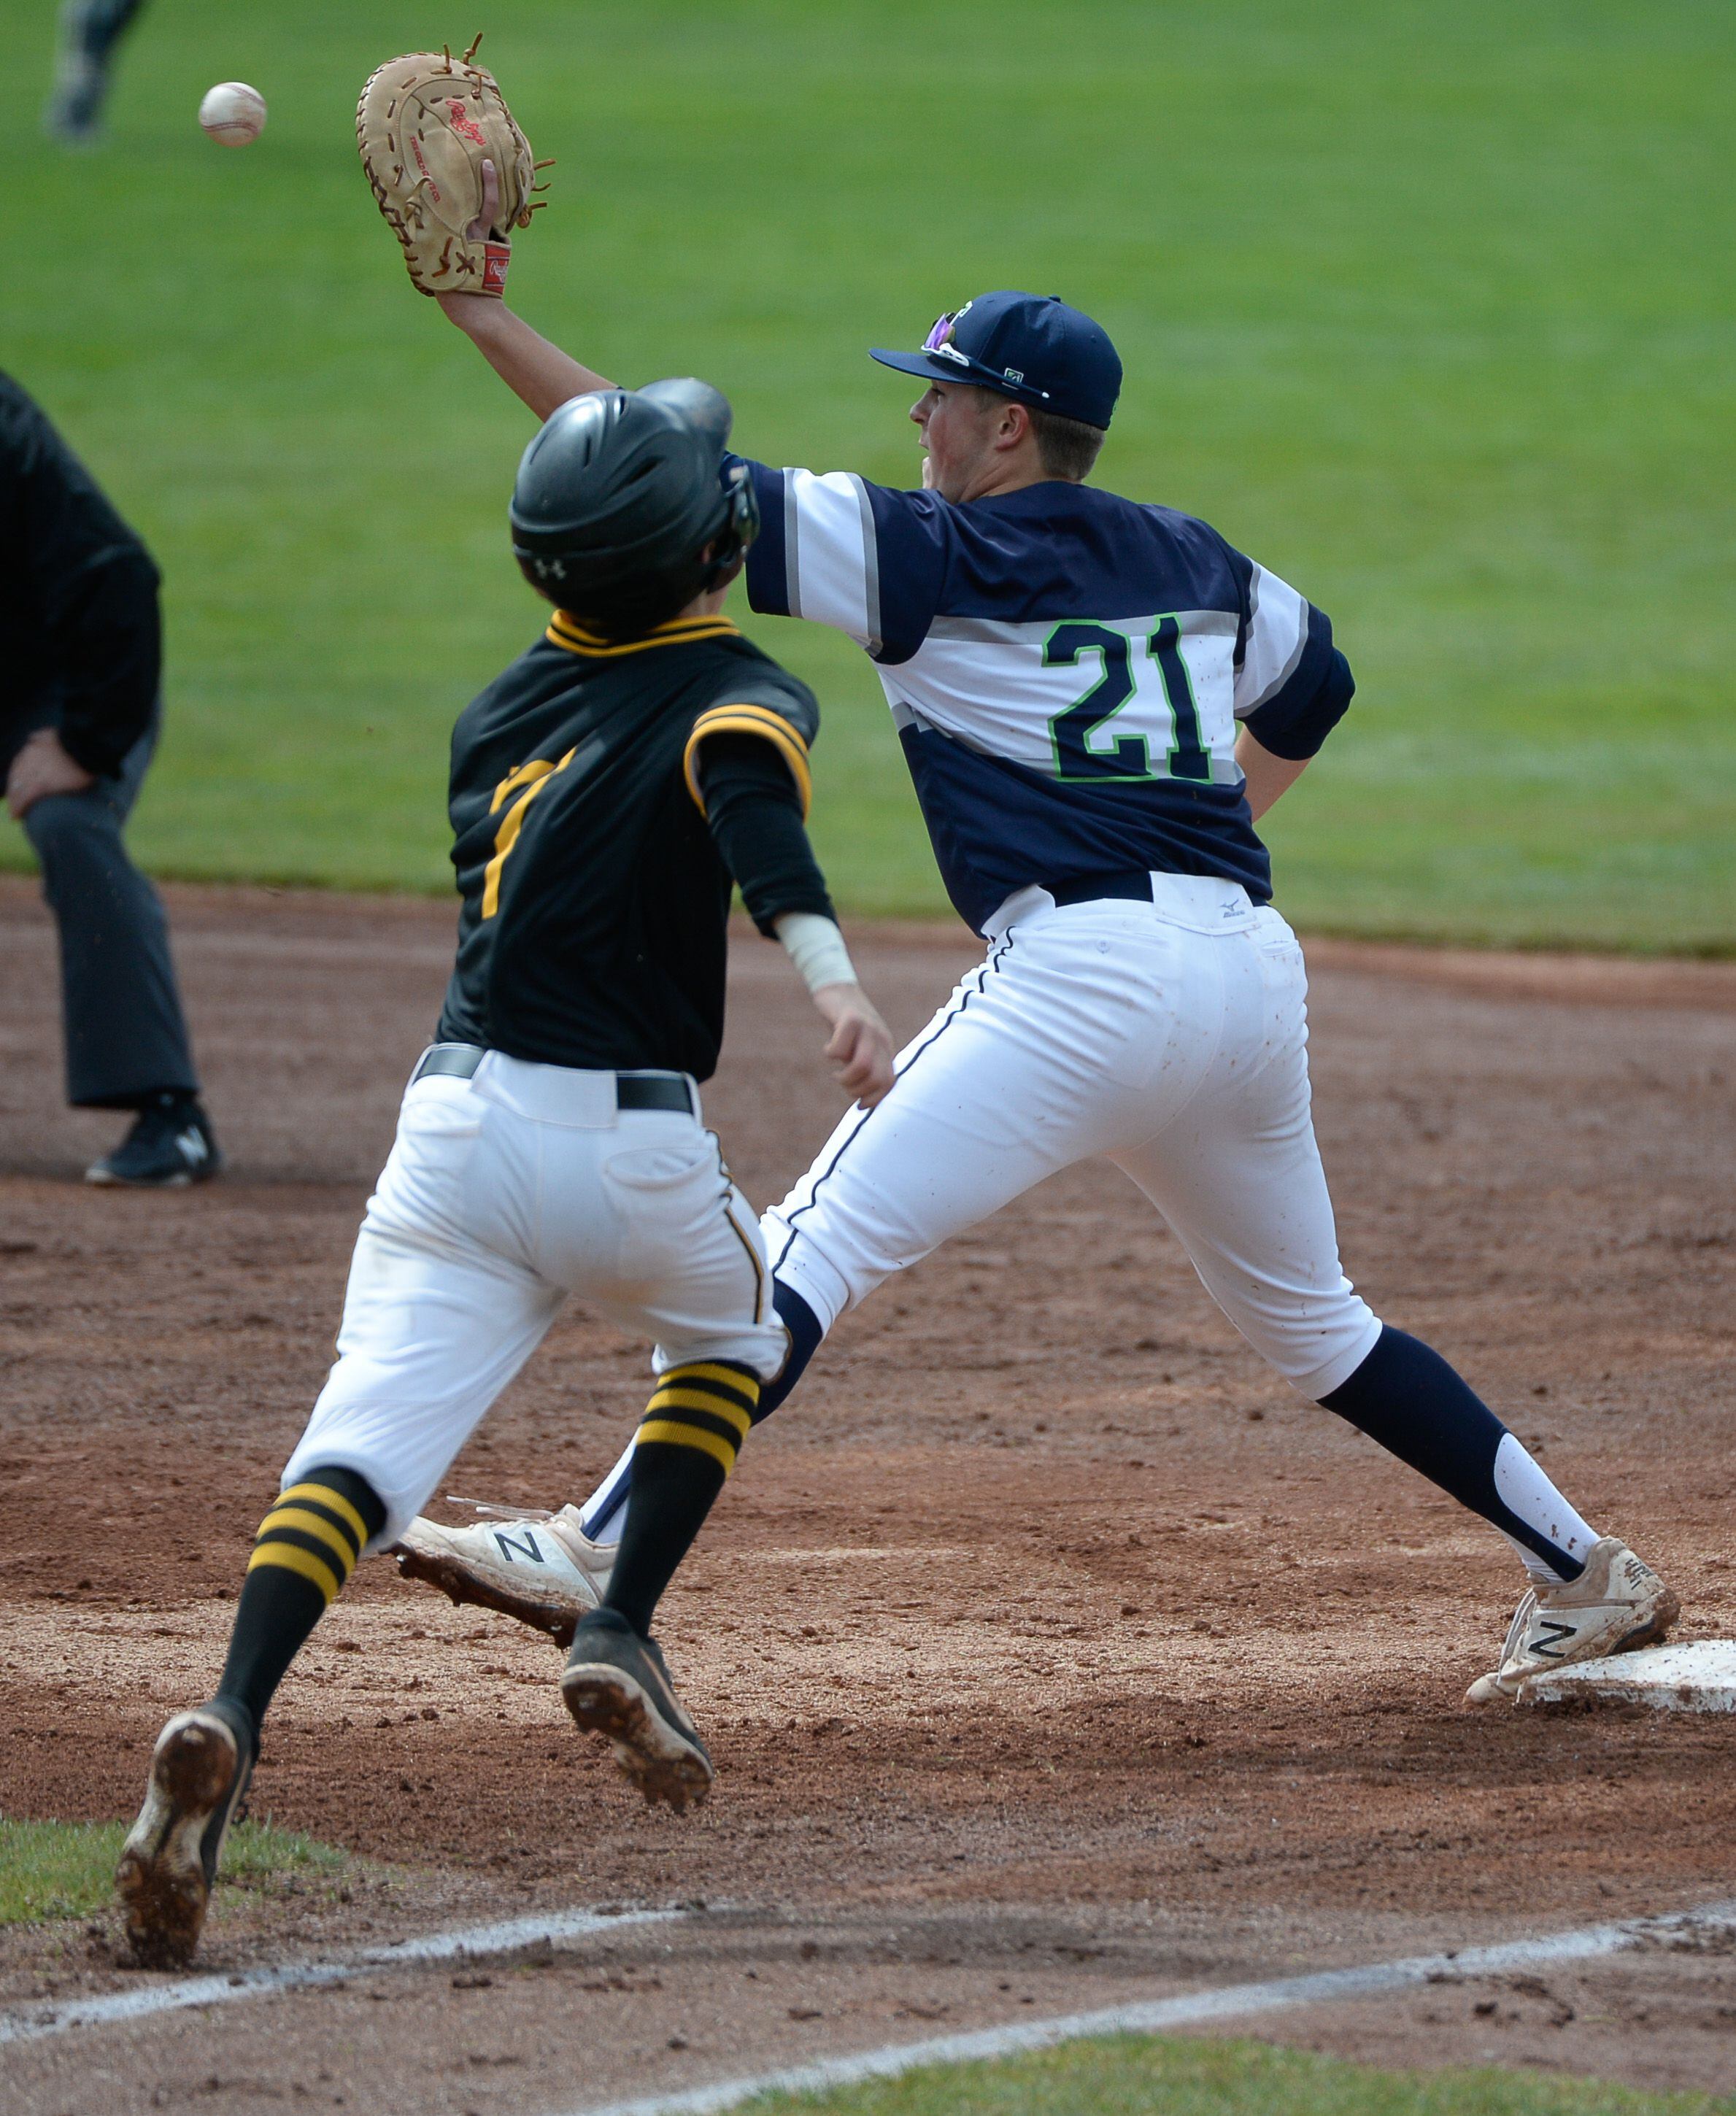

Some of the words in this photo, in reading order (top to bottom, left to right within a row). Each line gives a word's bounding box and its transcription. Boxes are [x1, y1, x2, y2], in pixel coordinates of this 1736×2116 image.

[1041, 611, 1214, 784] 21
[482, 746, 577, 919] 7
[493, 1531, 544, 1563] N
[1528, 1621, 1578, 1659] N
